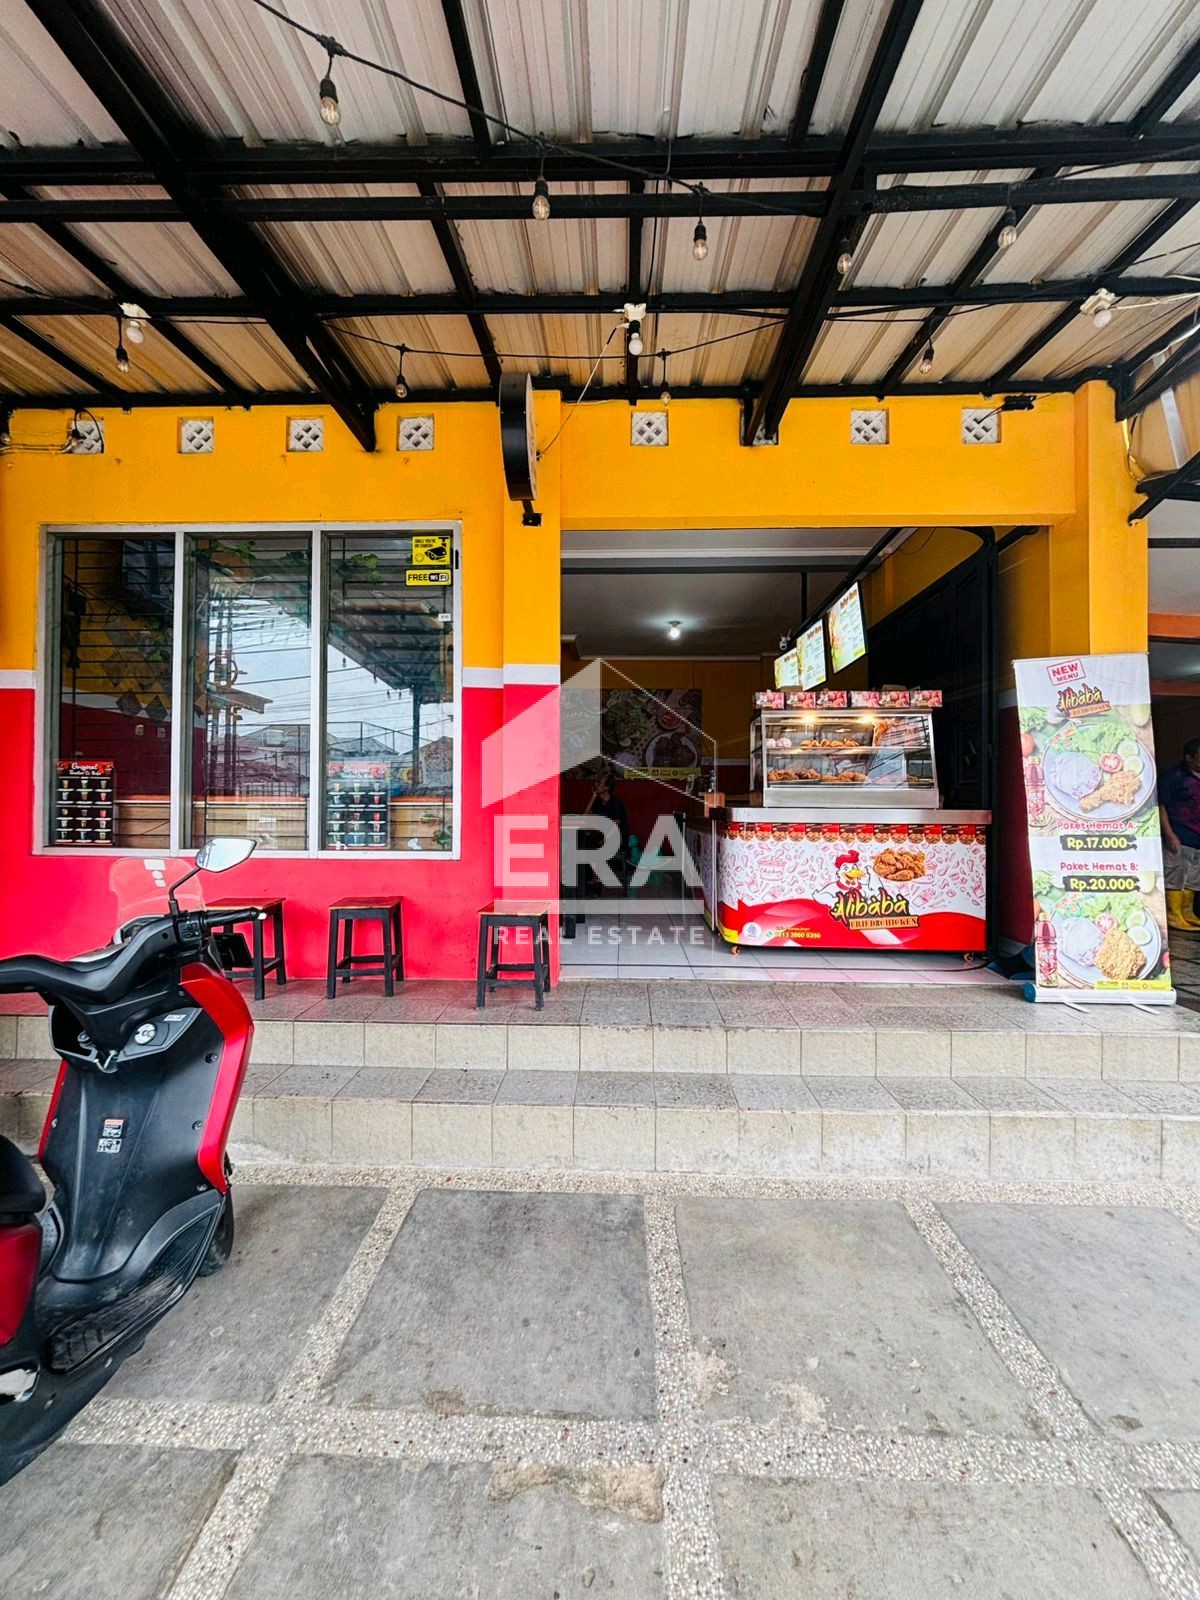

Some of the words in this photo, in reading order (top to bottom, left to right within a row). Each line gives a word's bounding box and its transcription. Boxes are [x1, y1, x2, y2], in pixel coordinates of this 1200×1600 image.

[408, 573, 428, 581] FREE
[1052, 662, 1079, 677] NEW
[1056, 672, 1079, 683] MENU
[1057, 684, 1102, 713] Alibaba
[1057, 822, 1086, 830] Paket
[1089, 821, 1124, 830] Hemat
[1067, 837, 1128, 850] Rp.17.000
[1060, 862, 1090, 870] Paket
[1092, 862, 1127, 870] Hemat
[1070, 878, 1135, 892] Rp.20.000
[831, 889, 908, 924] Alibaba
[850, 918, 875, 928] FRIED
[878, 917, 917, 928] CHICKEN
